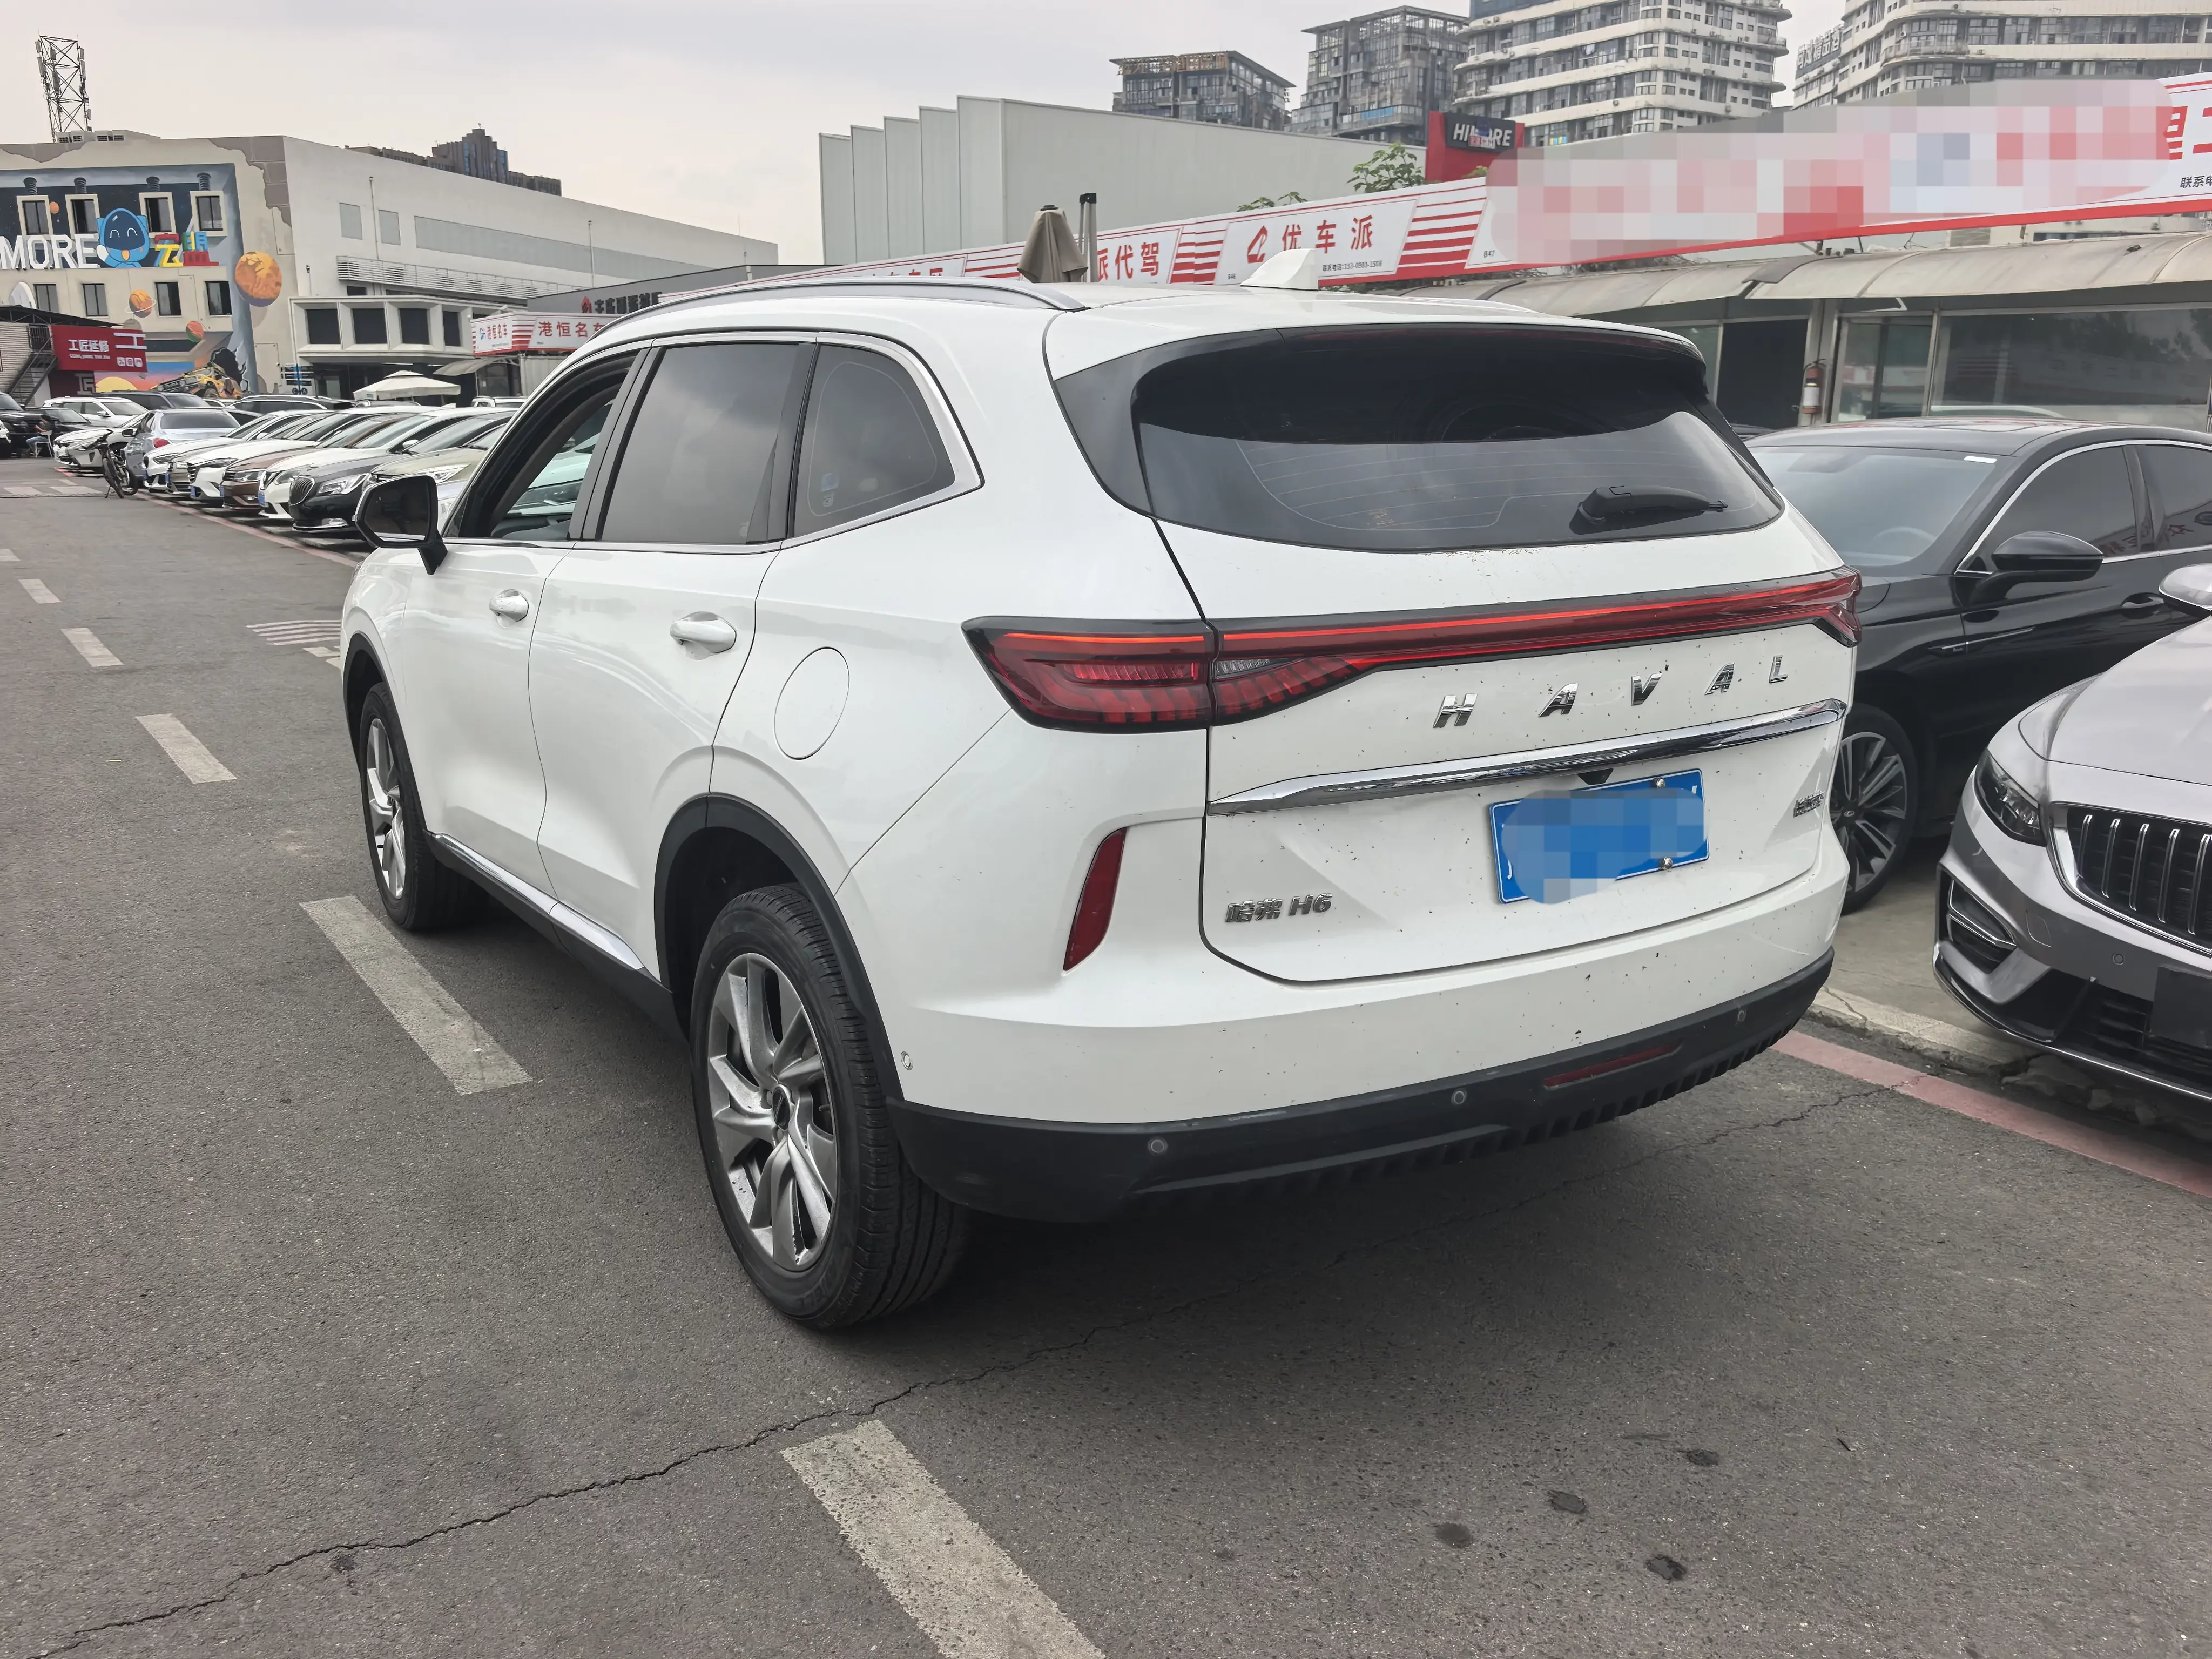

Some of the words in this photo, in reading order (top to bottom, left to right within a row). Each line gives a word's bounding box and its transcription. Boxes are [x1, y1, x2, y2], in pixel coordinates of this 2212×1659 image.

[0, 233, 100, 269] MORE
[1282, 215, 1373, 254] 优车派
[1433, 655, 1789, 729] HAVAL
[1288, 892, 1333, 917] H6
